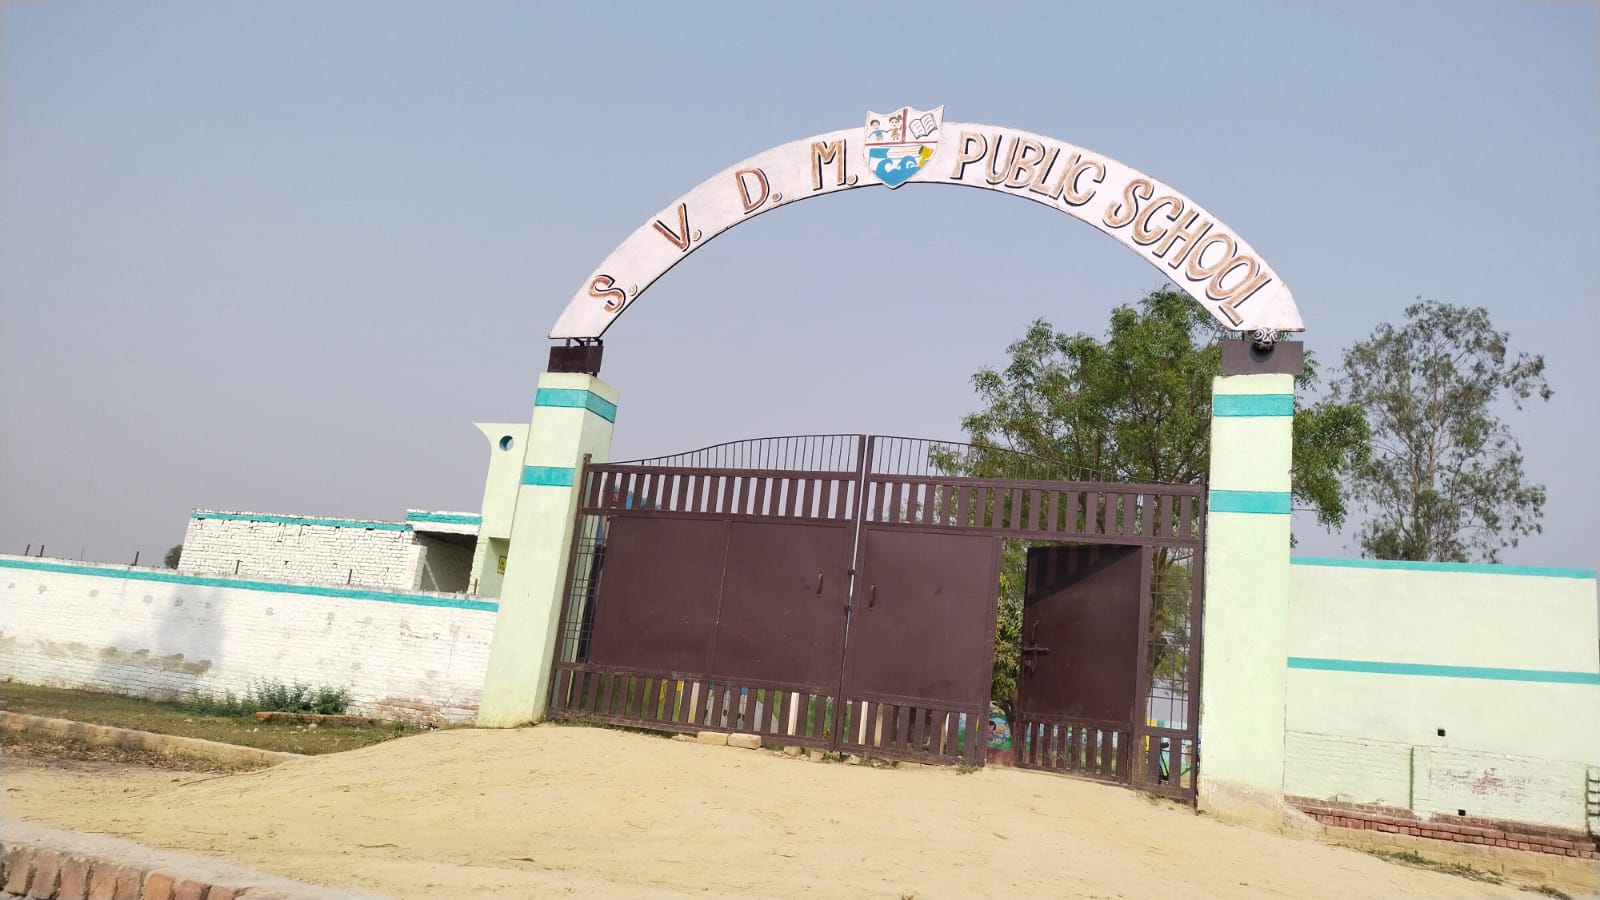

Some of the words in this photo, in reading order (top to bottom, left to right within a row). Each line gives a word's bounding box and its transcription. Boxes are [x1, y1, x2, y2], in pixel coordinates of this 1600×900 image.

[588, 274, 638, 313] S.
[652, 203, 702, 252] V.
[735, 167, 782, 214] D.
[811, 138, 858, 191] M.
[950, 130, 1106, 207] PUBLIC
[1102, 178, 1272, 326] SCHOOL
